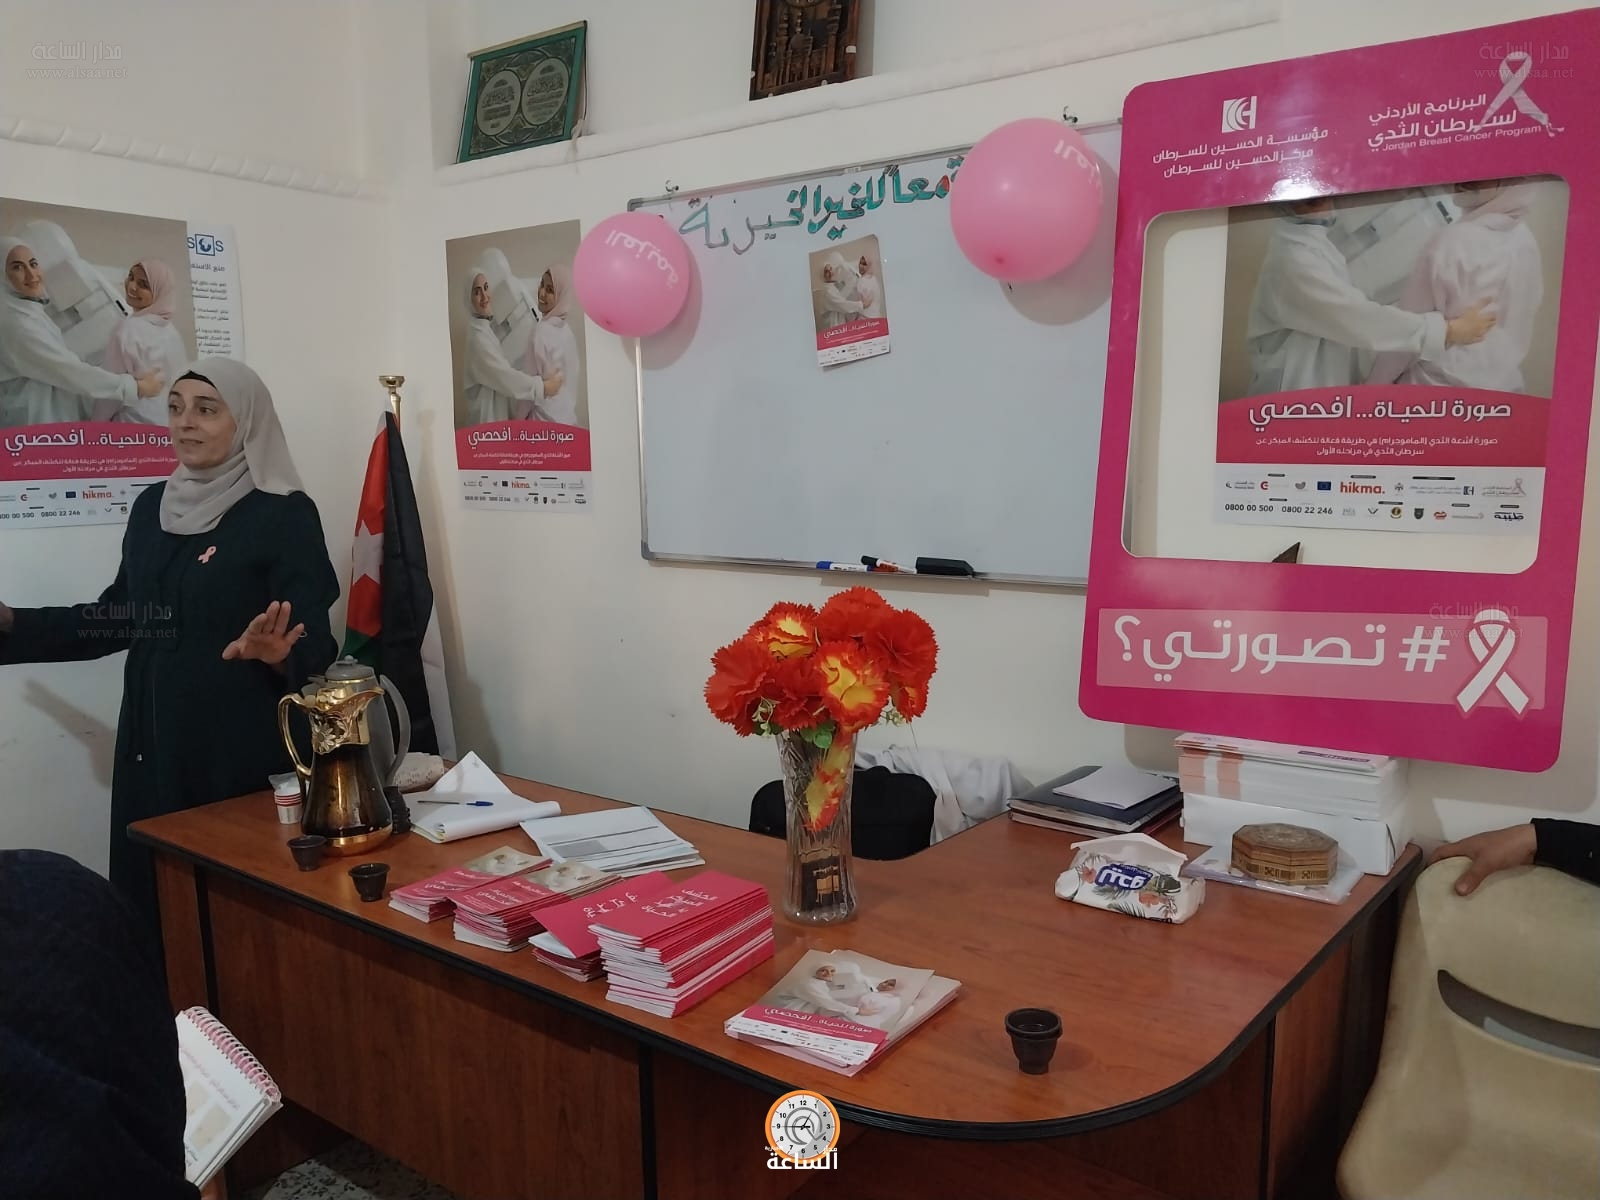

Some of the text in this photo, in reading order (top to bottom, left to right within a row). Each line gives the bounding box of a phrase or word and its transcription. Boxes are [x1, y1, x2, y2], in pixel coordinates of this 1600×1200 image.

[1369, 93, 1486, 126] البرنامج الأردني
[1367, 109, 1517, 151] لسرطان الثدي
[1383, 125, 1542, 152] Jordan Breast Cancer Program
[1152, 126, 1329, 164] مؤسسة الحسين للسرطان
[1164, 149, 1314, 178] مركز الحسين للسرطان
[1249, 395, 1353, 432] افحصي
[1451, 399, 1511, 422] صورة
[4, 428, 85, 456] افحصي
[148, 432, 173, 448] ورة
[468, 426, 511, 449] افحصي
[550, 429, 574, 444] صورة
[1395, 447, 1424, 456] سرطان
[1340, 482, 1385, 494] hikma.
[1225, 503, 1244, 511] 0800
[1246, 504, 1257, 512] 00
[1281, 505, 1302, 514] 0800
[1317, 507, 1333, 515] 246
